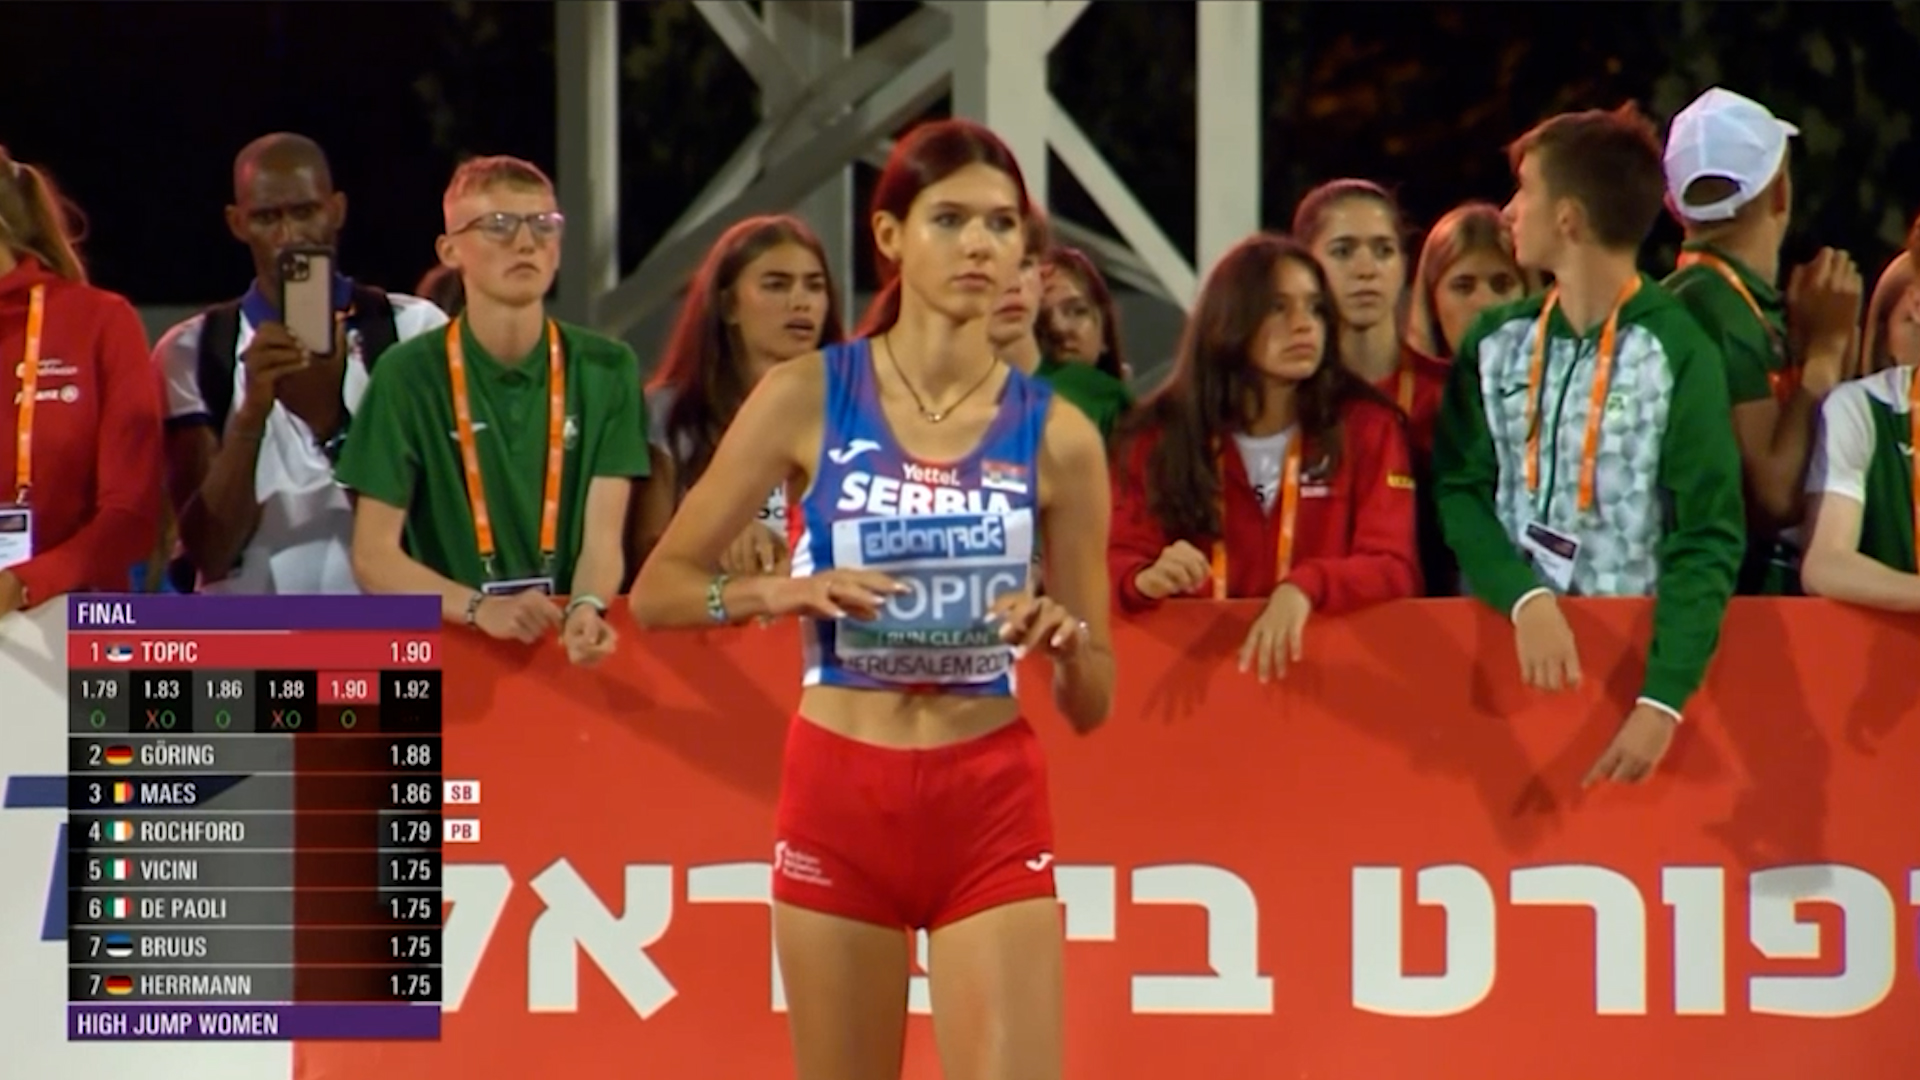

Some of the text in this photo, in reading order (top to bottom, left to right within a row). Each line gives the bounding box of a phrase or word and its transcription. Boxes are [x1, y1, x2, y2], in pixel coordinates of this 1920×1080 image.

[837, 472, 1013, 516] SERBIA
[885, 572, 1017, 621] OPIC
[930, 630, 989, 646] CLEAN
[1352, 863, 1920, 1018] פורט
